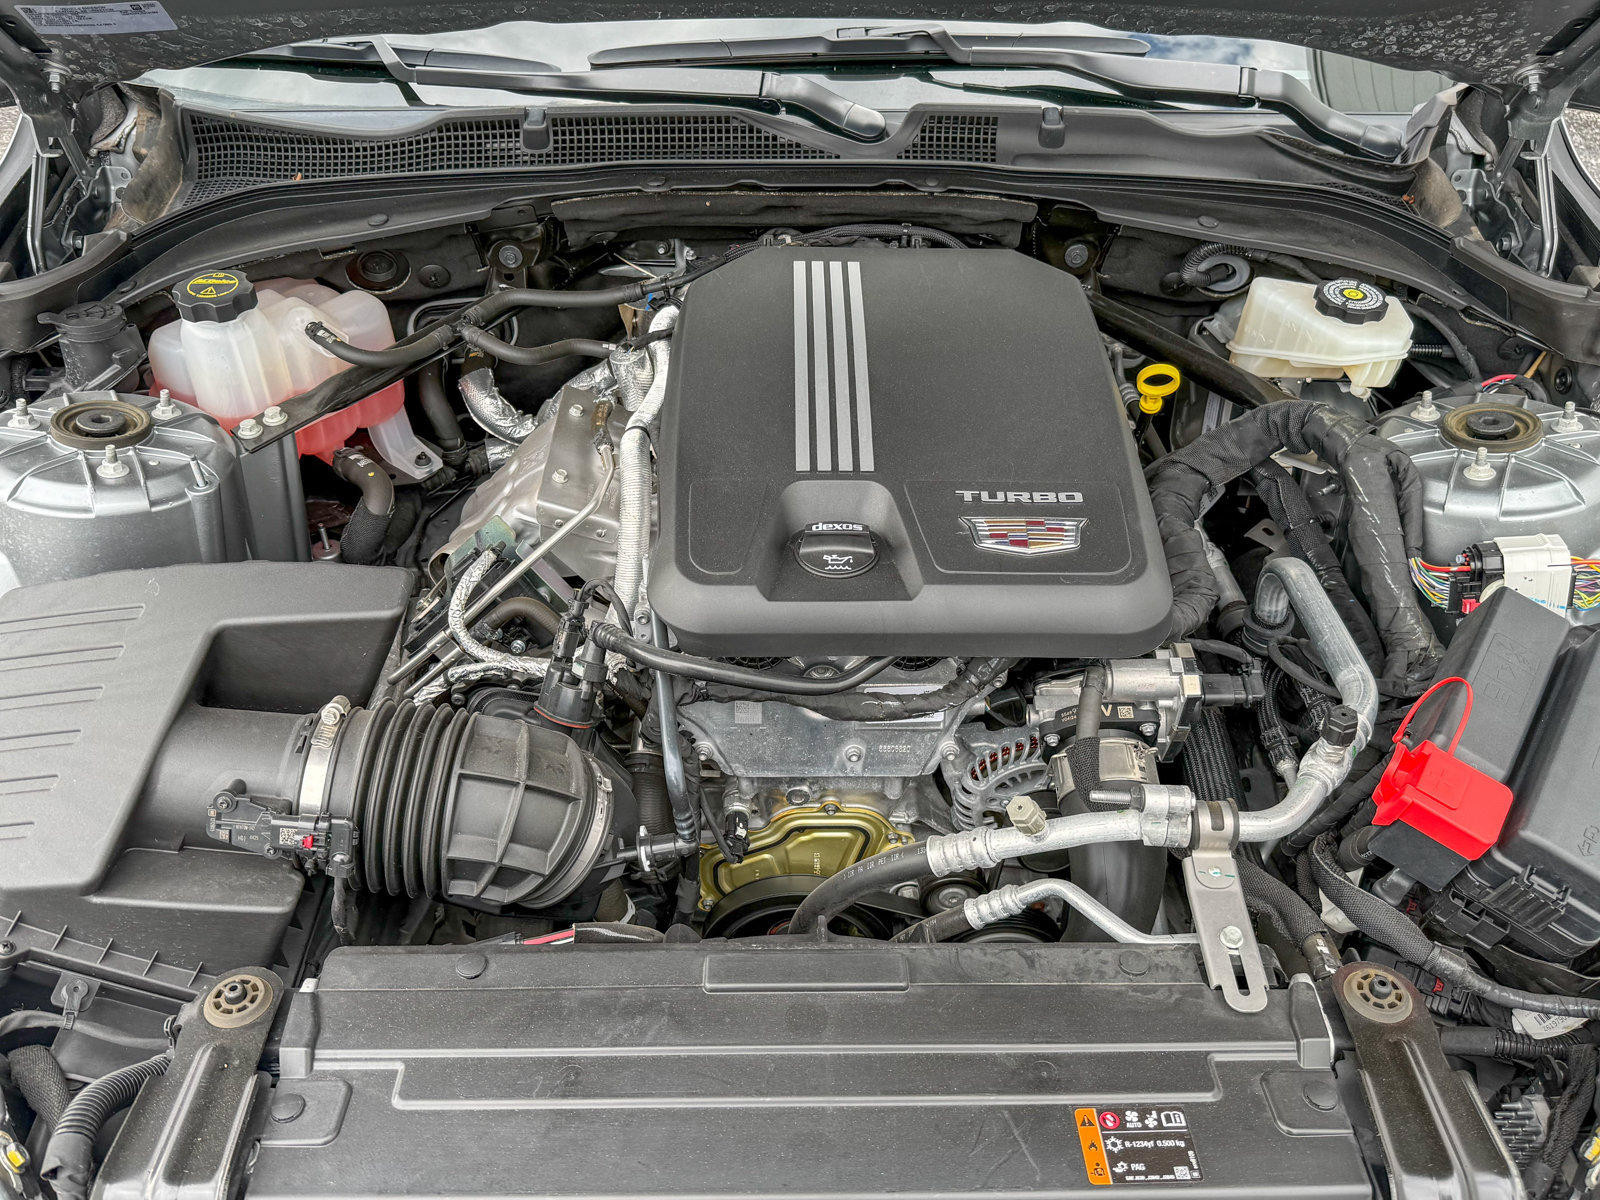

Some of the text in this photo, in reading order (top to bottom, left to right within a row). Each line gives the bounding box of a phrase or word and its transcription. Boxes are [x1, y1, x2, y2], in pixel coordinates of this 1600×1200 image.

[955, 491, 1083, 503] TURBO
[811, 522, 865, 531] dexos
[1124, 1139, 1186, 1148] R-1234yf 0.500 kg
[1131, 1163, 1146, 1171] PAG
